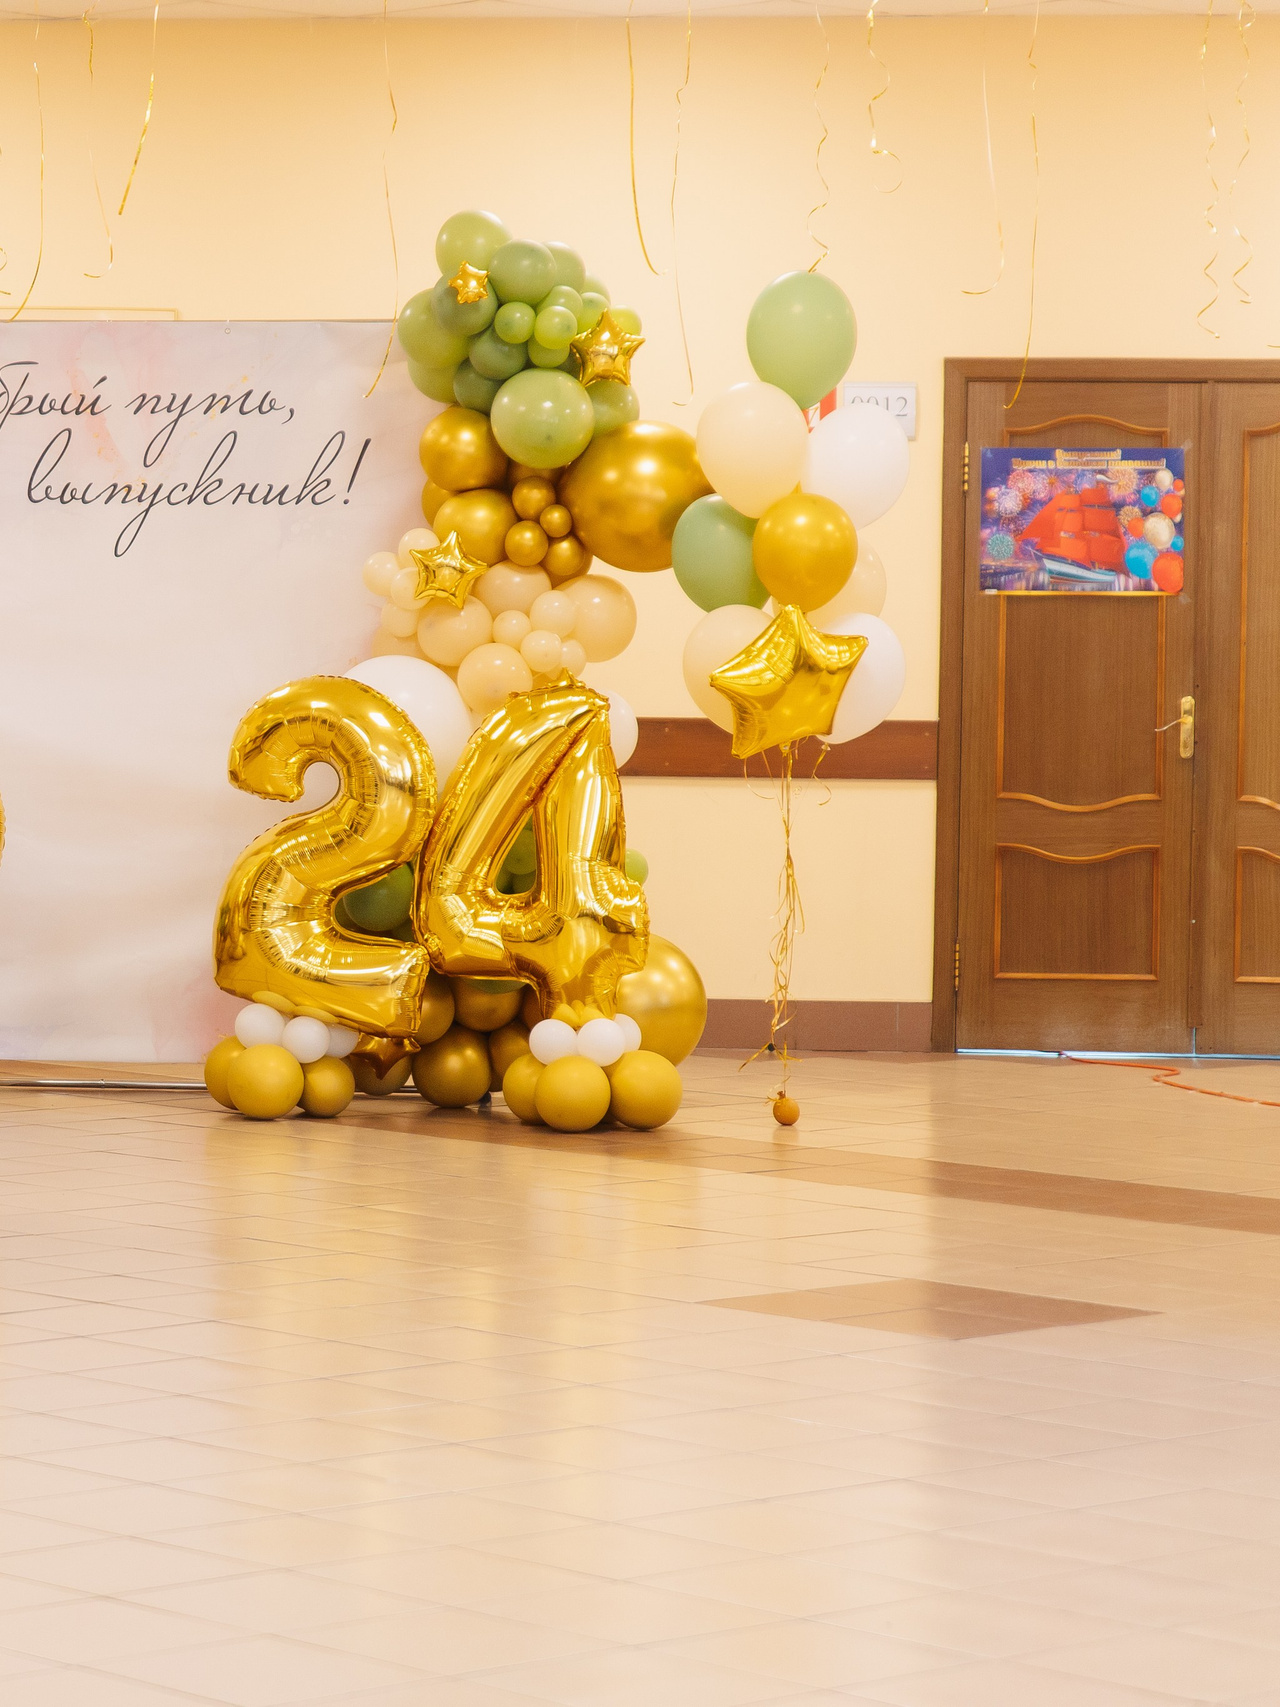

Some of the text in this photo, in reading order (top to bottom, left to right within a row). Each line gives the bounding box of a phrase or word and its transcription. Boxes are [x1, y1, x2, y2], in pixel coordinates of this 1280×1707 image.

[27, 428, 371, 558] выпускник!
[124, 388, 296, 468] путь,
[212, 667, 651, 1040] 24
